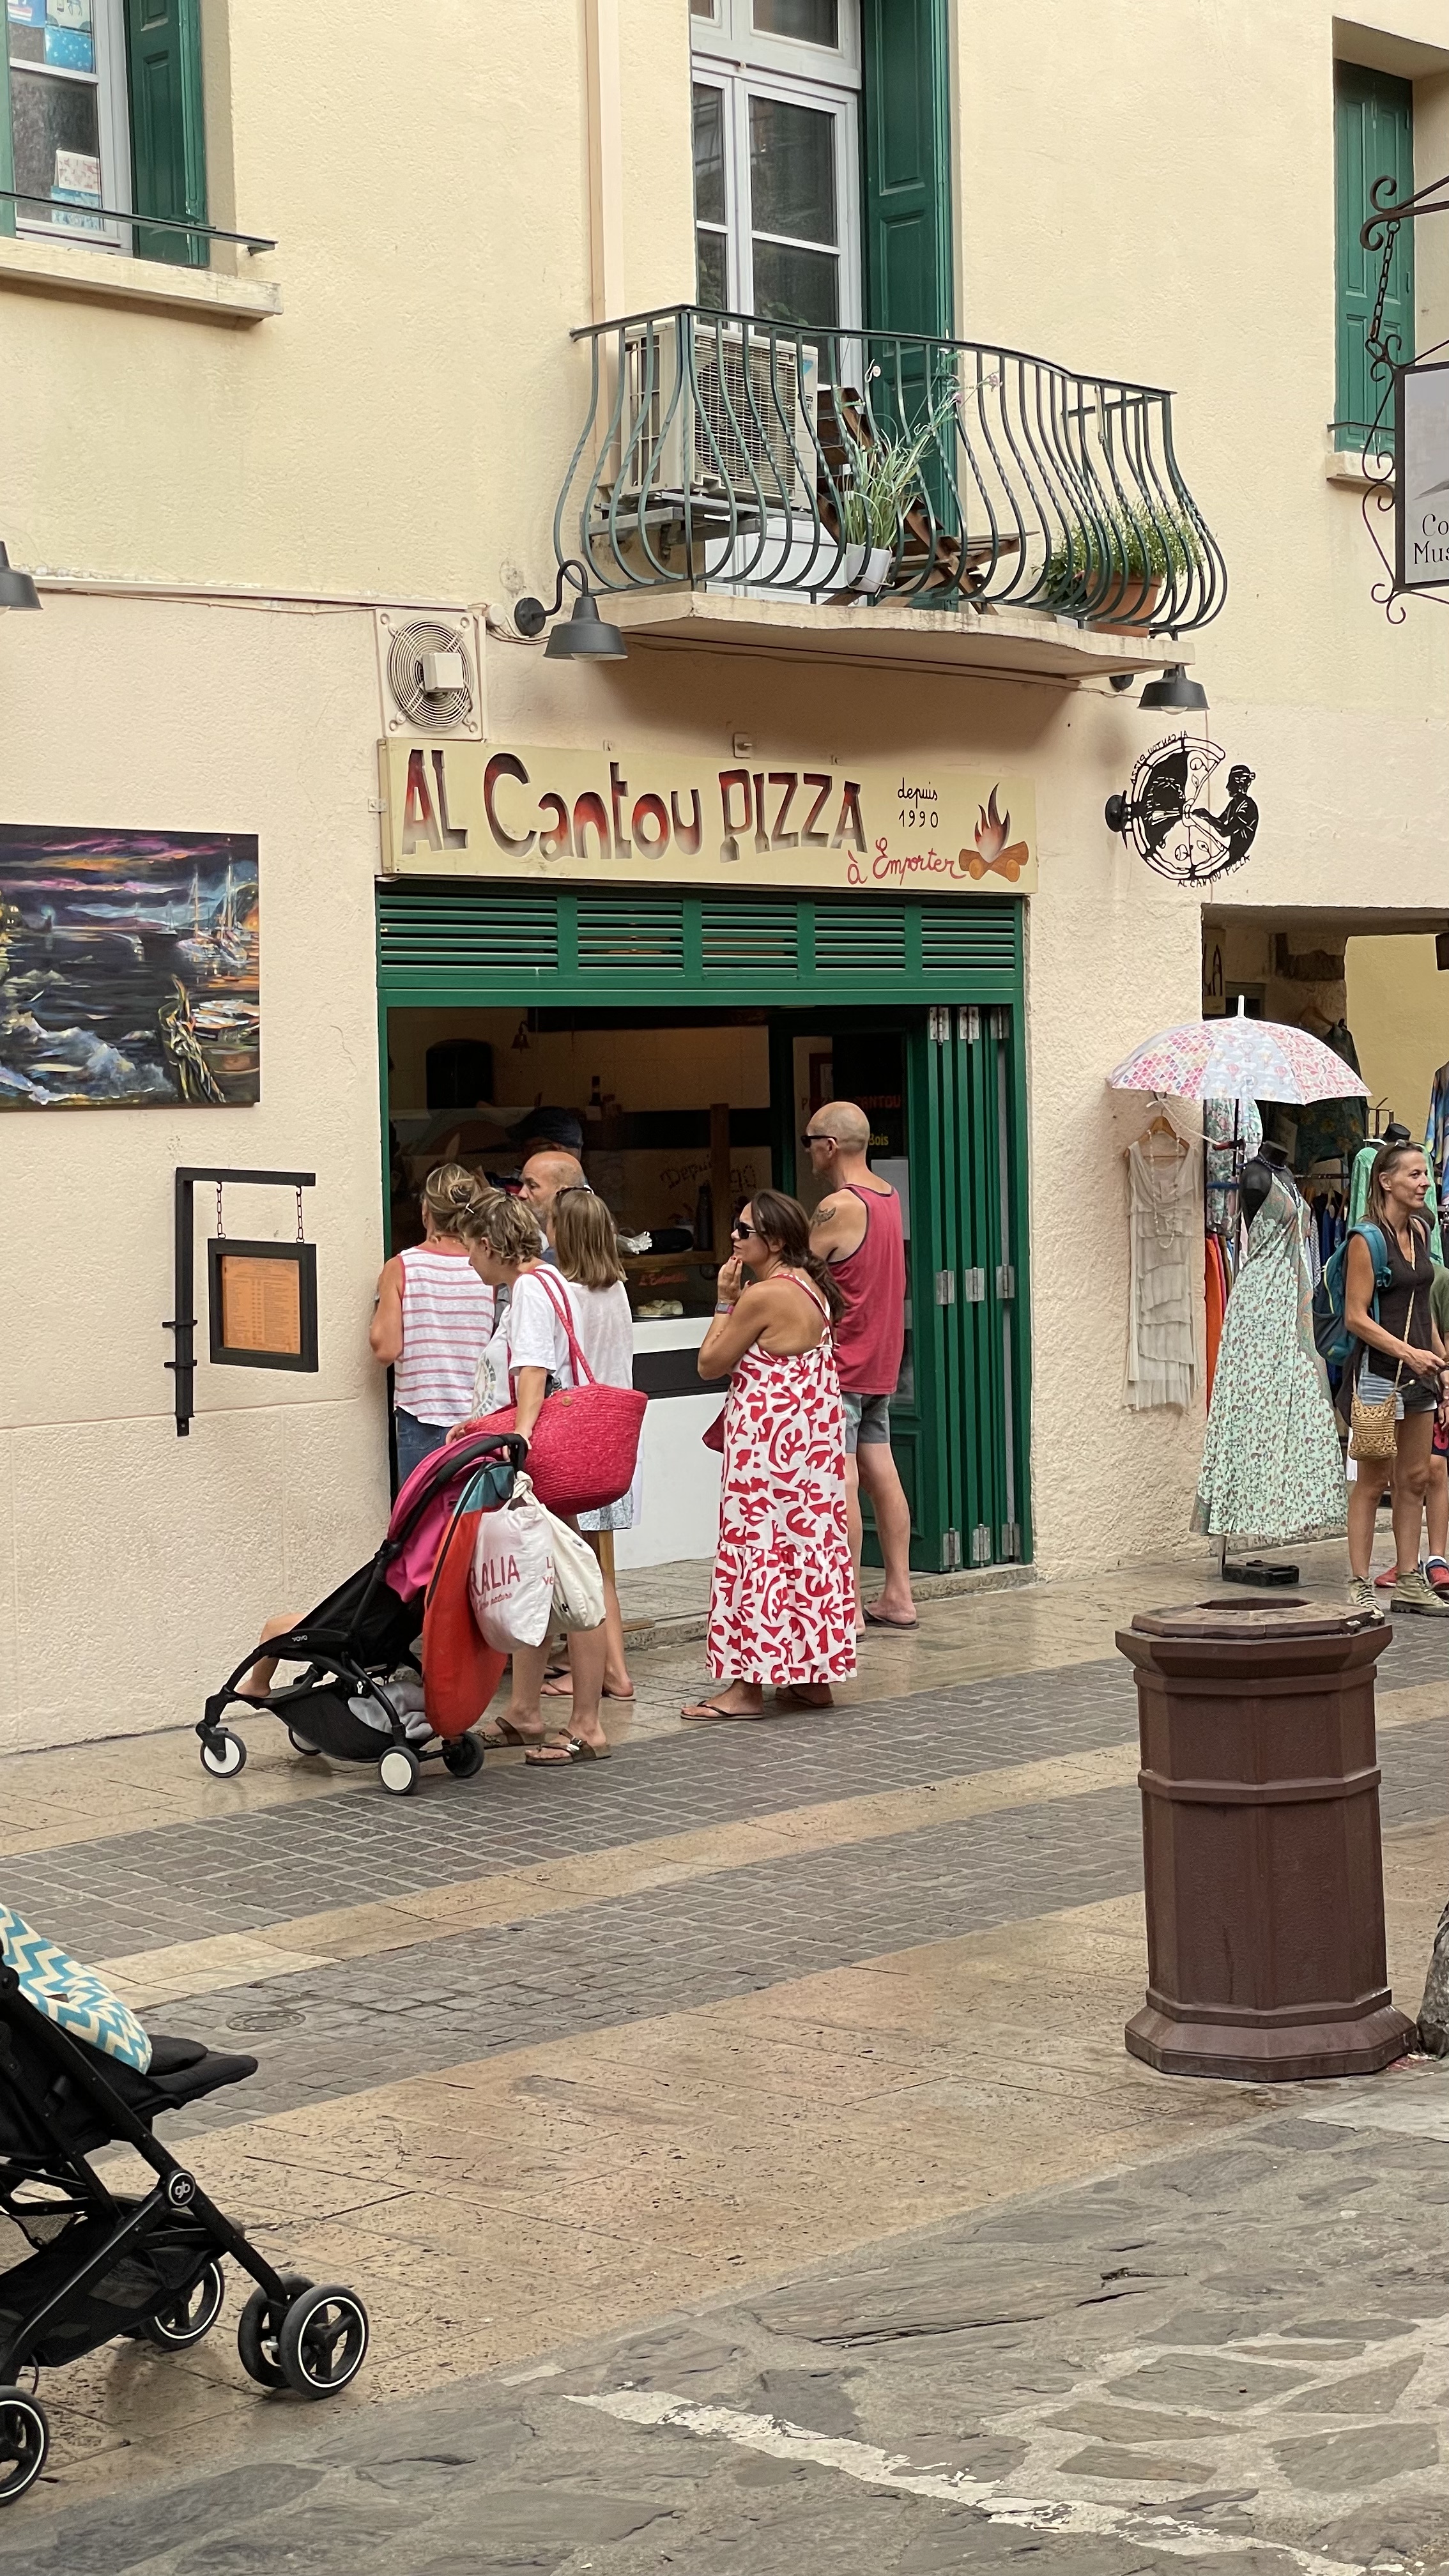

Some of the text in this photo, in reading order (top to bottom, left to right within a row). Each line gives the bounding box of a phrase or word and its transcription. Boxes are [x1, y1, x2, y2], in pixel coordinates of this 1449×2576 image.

[897, 777, 938, 809] depuis
[402, 749, 868, 863] AL Cantou PIZZA
[898, 809, 939, 828] 1990
[847, 837, 967, 885] à Emporter
[860, 1094, 901, 1108] ANTOU
[869, 1133, 889, 1146] Bois
[659, 1154, 712, 1189] Depui
[175, 2181, 190, 2198] gb
